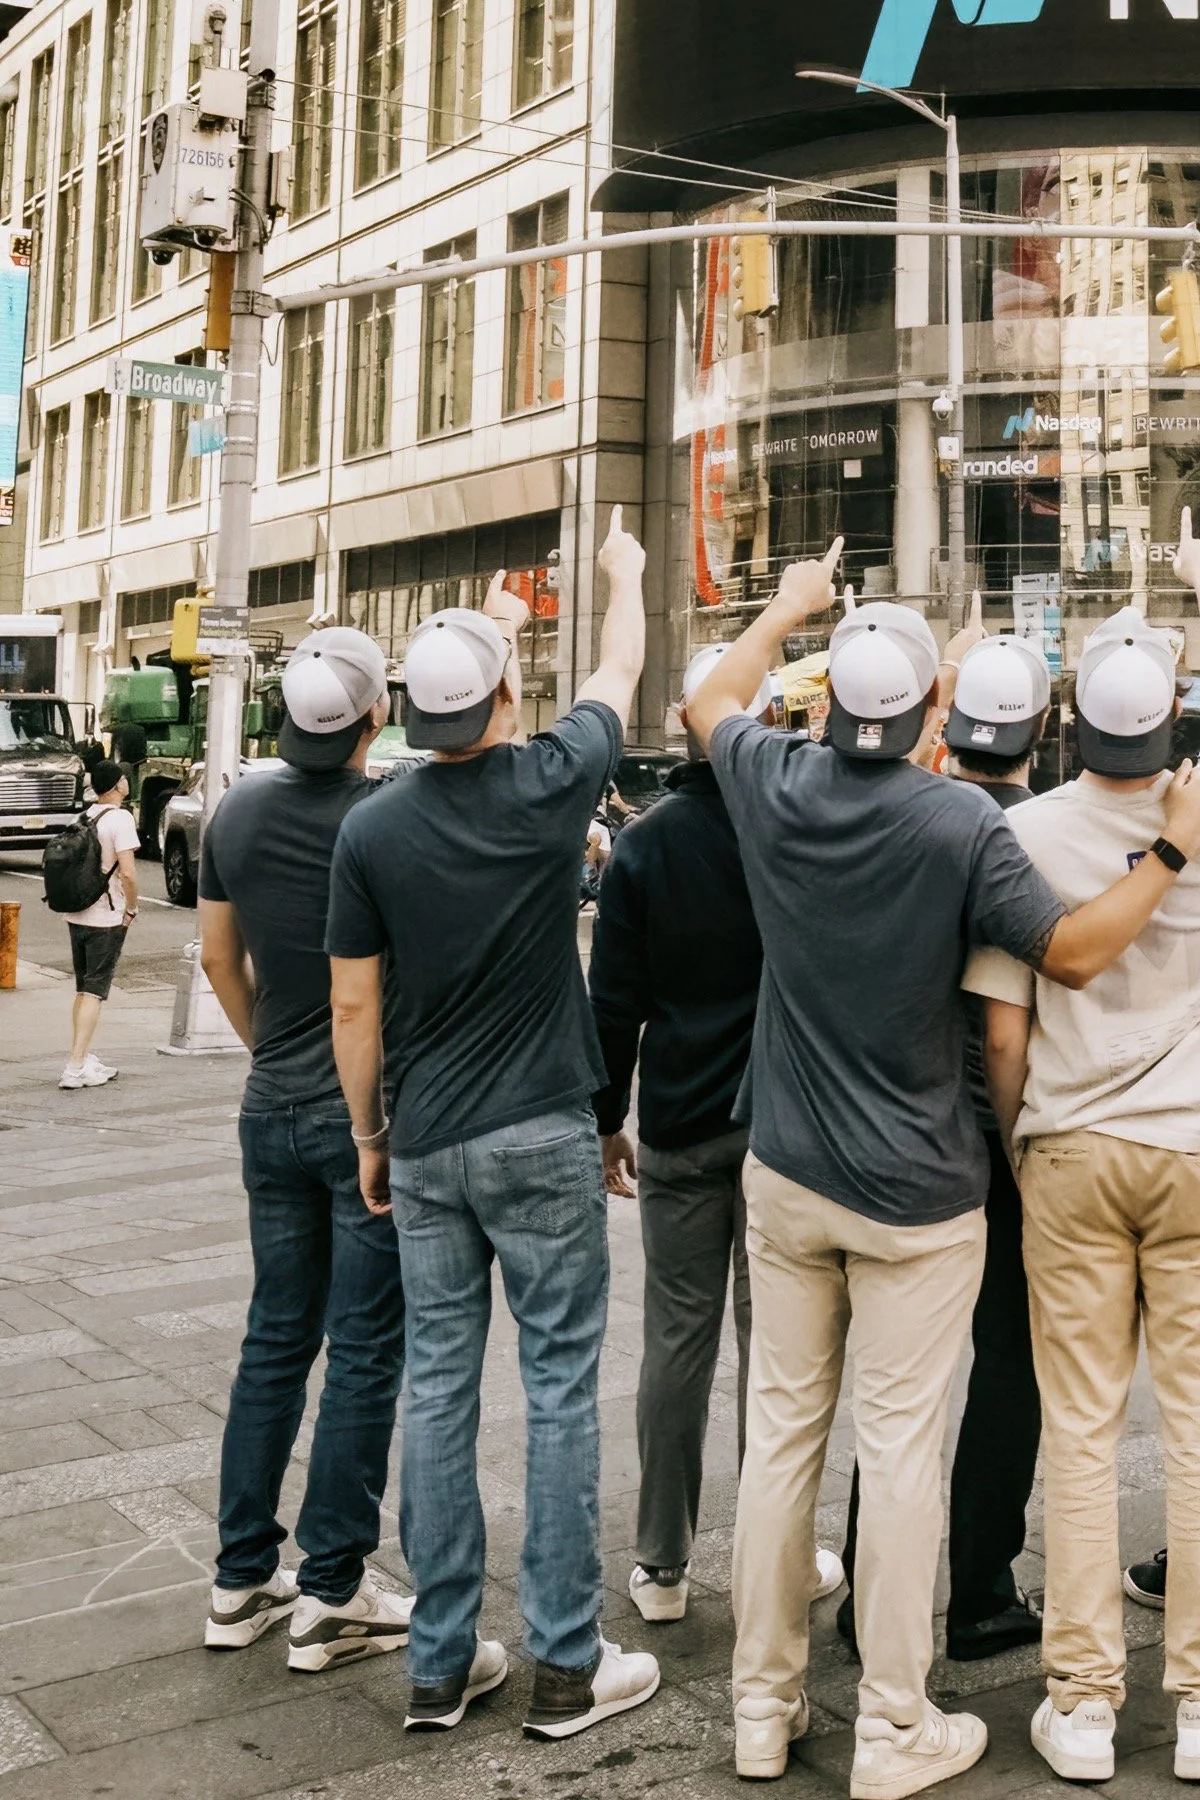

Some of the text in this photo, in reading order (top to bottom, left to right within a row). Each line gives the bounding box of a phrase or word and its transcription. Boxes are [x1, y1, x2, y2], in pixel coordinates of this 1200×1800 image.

[181, 147, 224, 169] 726156
[132, 365, 217, 404] Broadway
[1035, 413, 1102, 434] Nasdaq
[963, 455, 1039, 477] randed
